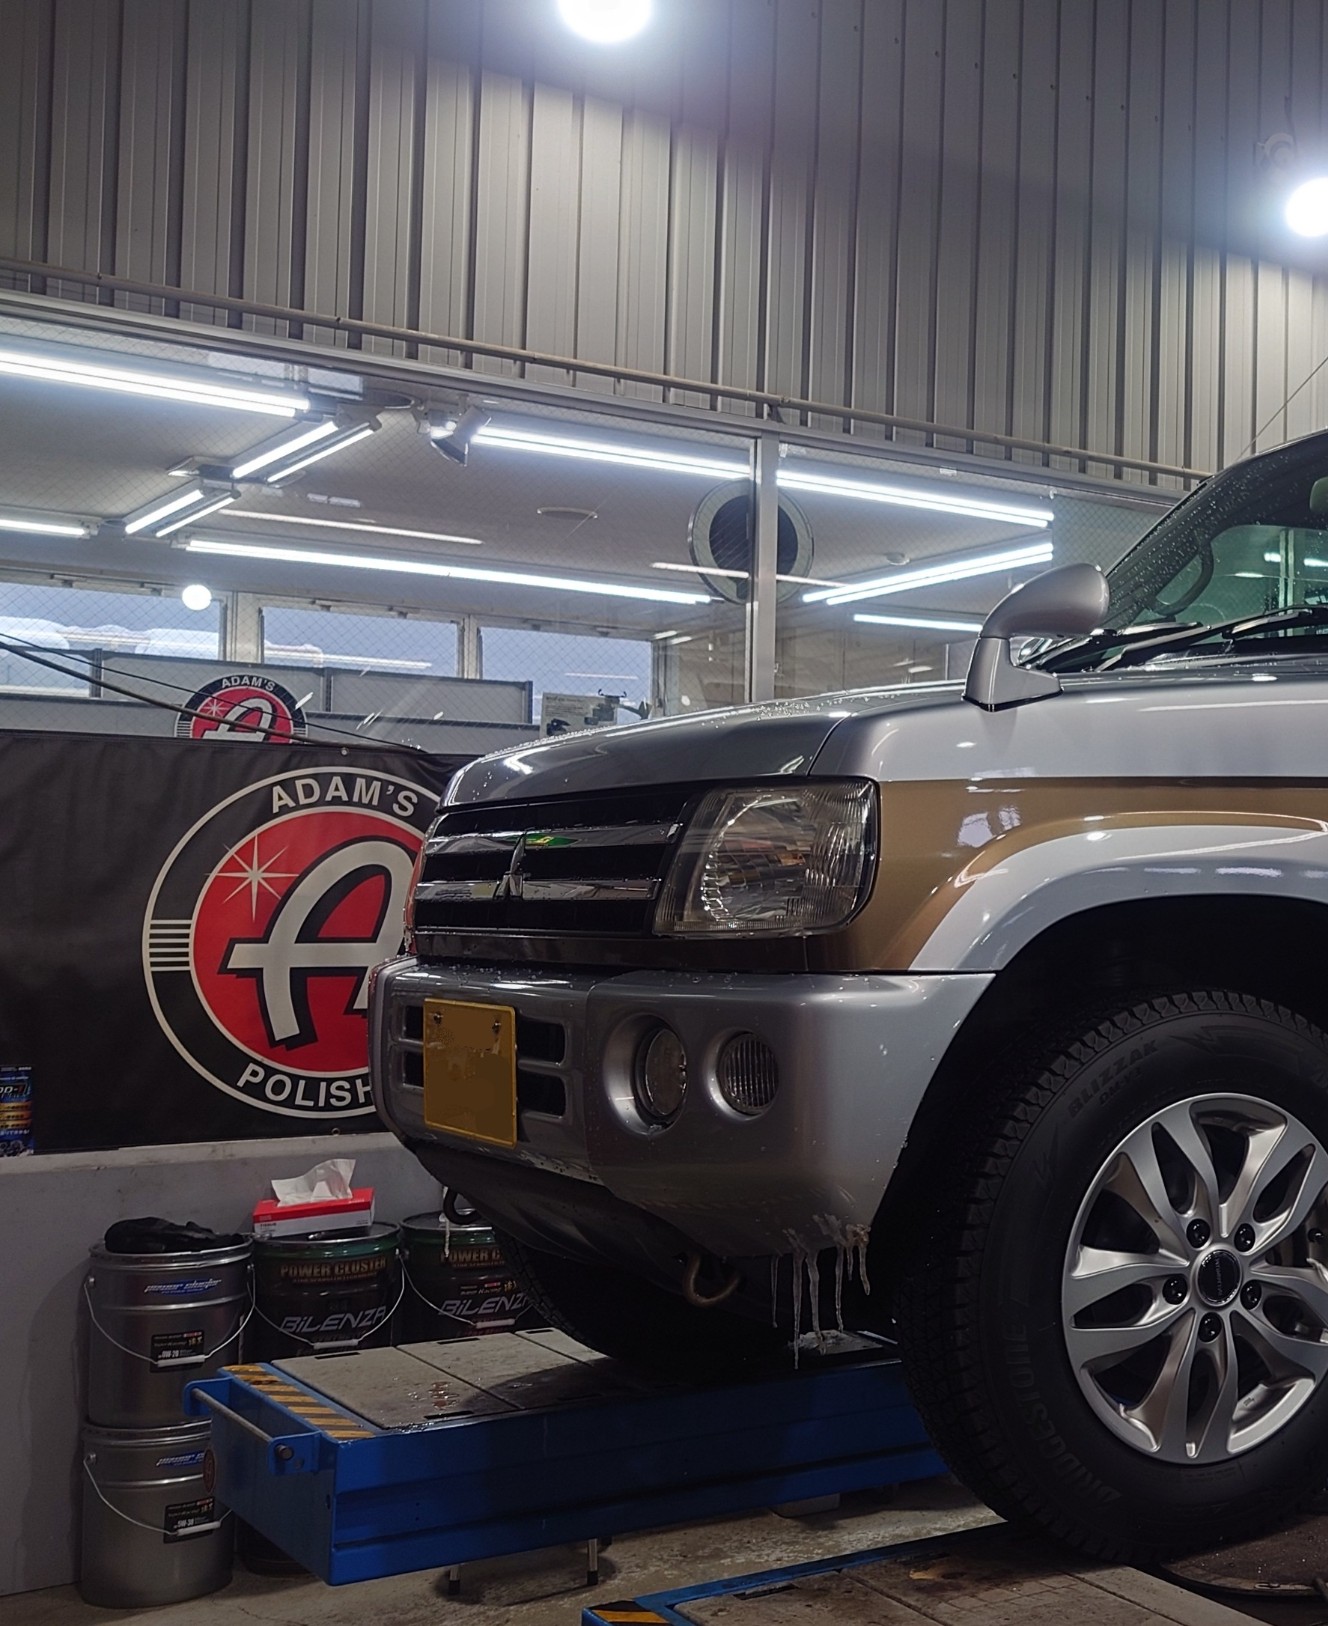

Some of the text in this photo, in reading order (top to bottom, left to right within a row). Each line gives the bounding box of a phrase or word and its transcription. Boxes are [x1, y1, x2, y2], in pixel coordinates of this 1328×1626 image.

[221, 676, 276, 691] ADAM'S
[271, 775, 419, 817] ADAM'S
[1067, 1040, 1158, 1117] BLIZZAK
[280, 1263, 331, 1278] POWER
[334, 1257, 387, 1276] CLUSTER
[1003, 1320, 1123, 1501] BRIDGESTONE
